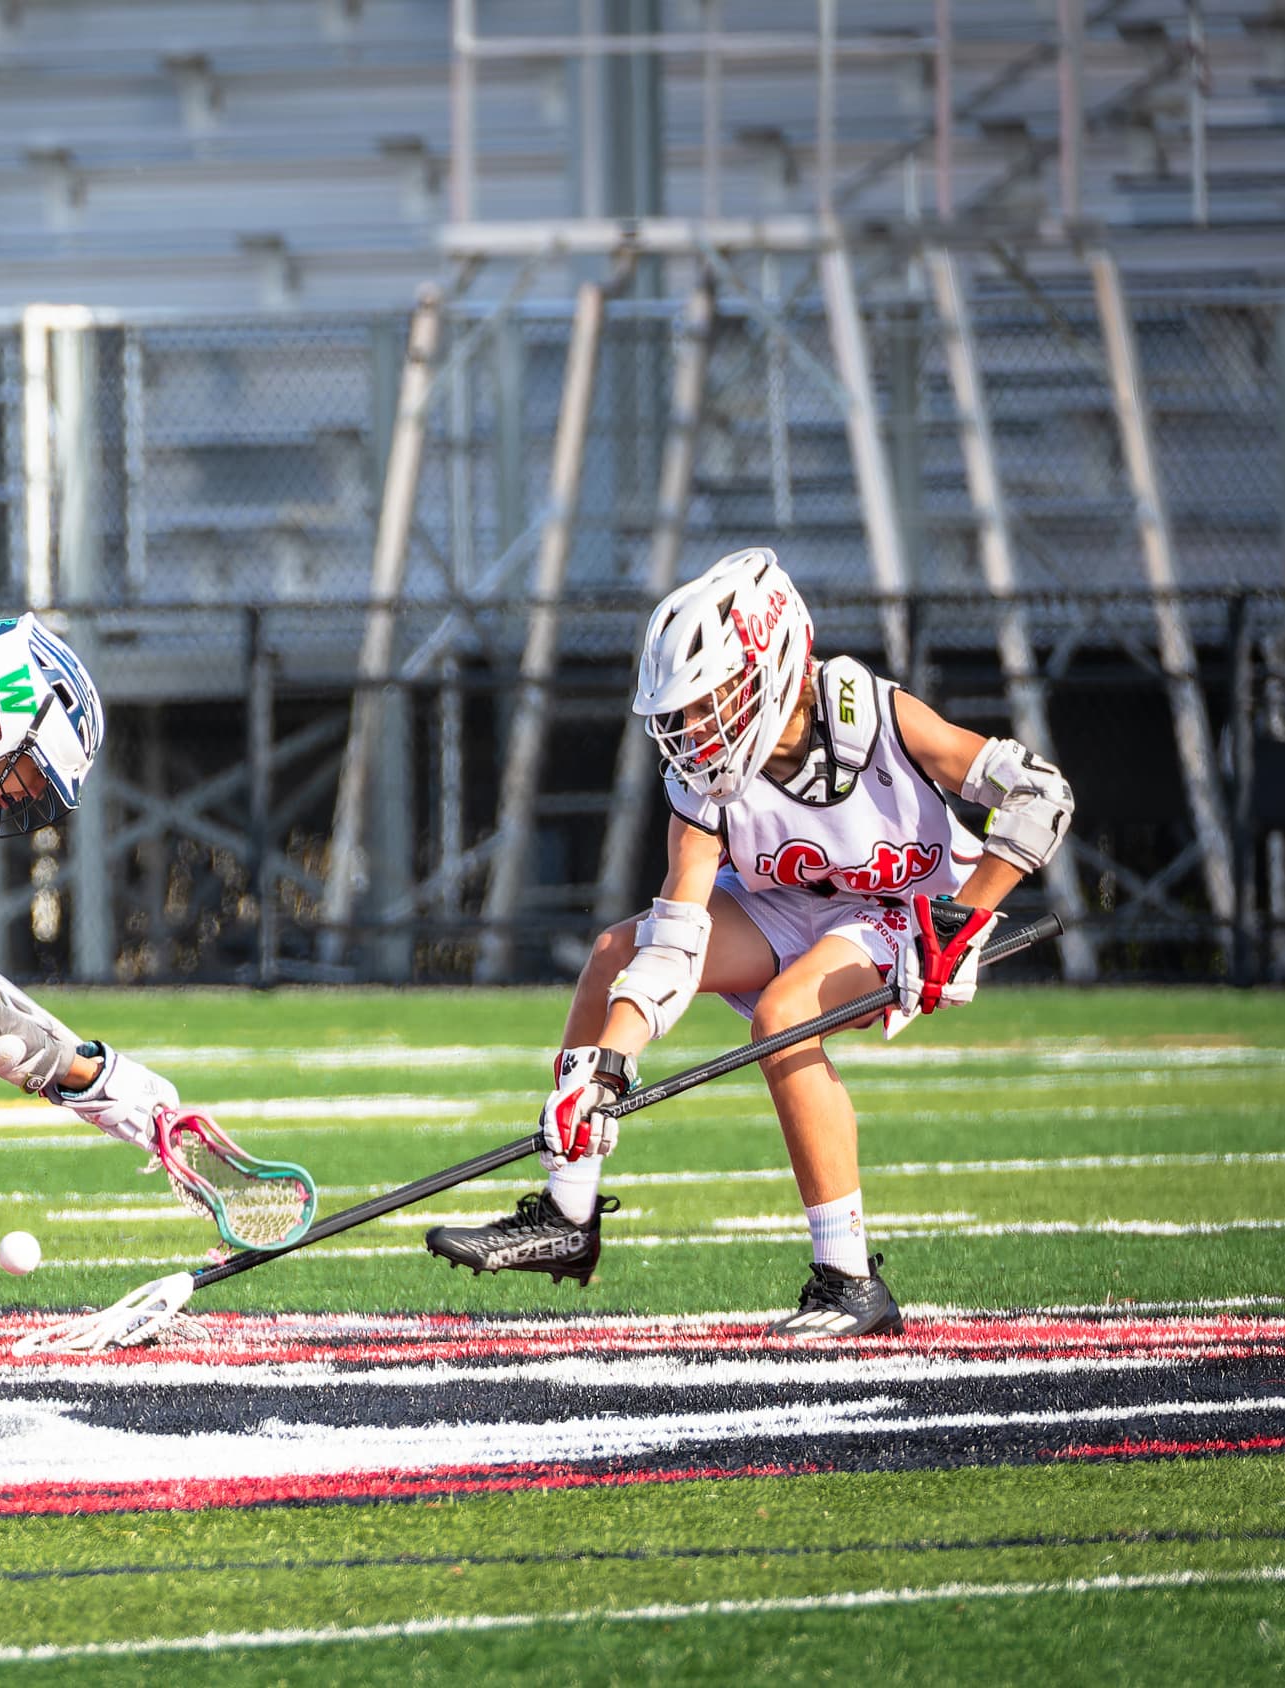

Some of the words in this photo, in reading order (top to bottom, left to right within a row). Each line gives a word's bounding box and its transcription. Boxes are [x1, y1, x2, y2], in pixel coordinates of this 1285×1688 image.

[748, 589, 788, 652] Cats
[839, 677, 856, 727] STX
[755, 838, 944, 894] Cats
[853, 910, 900, 956] LACROSS
